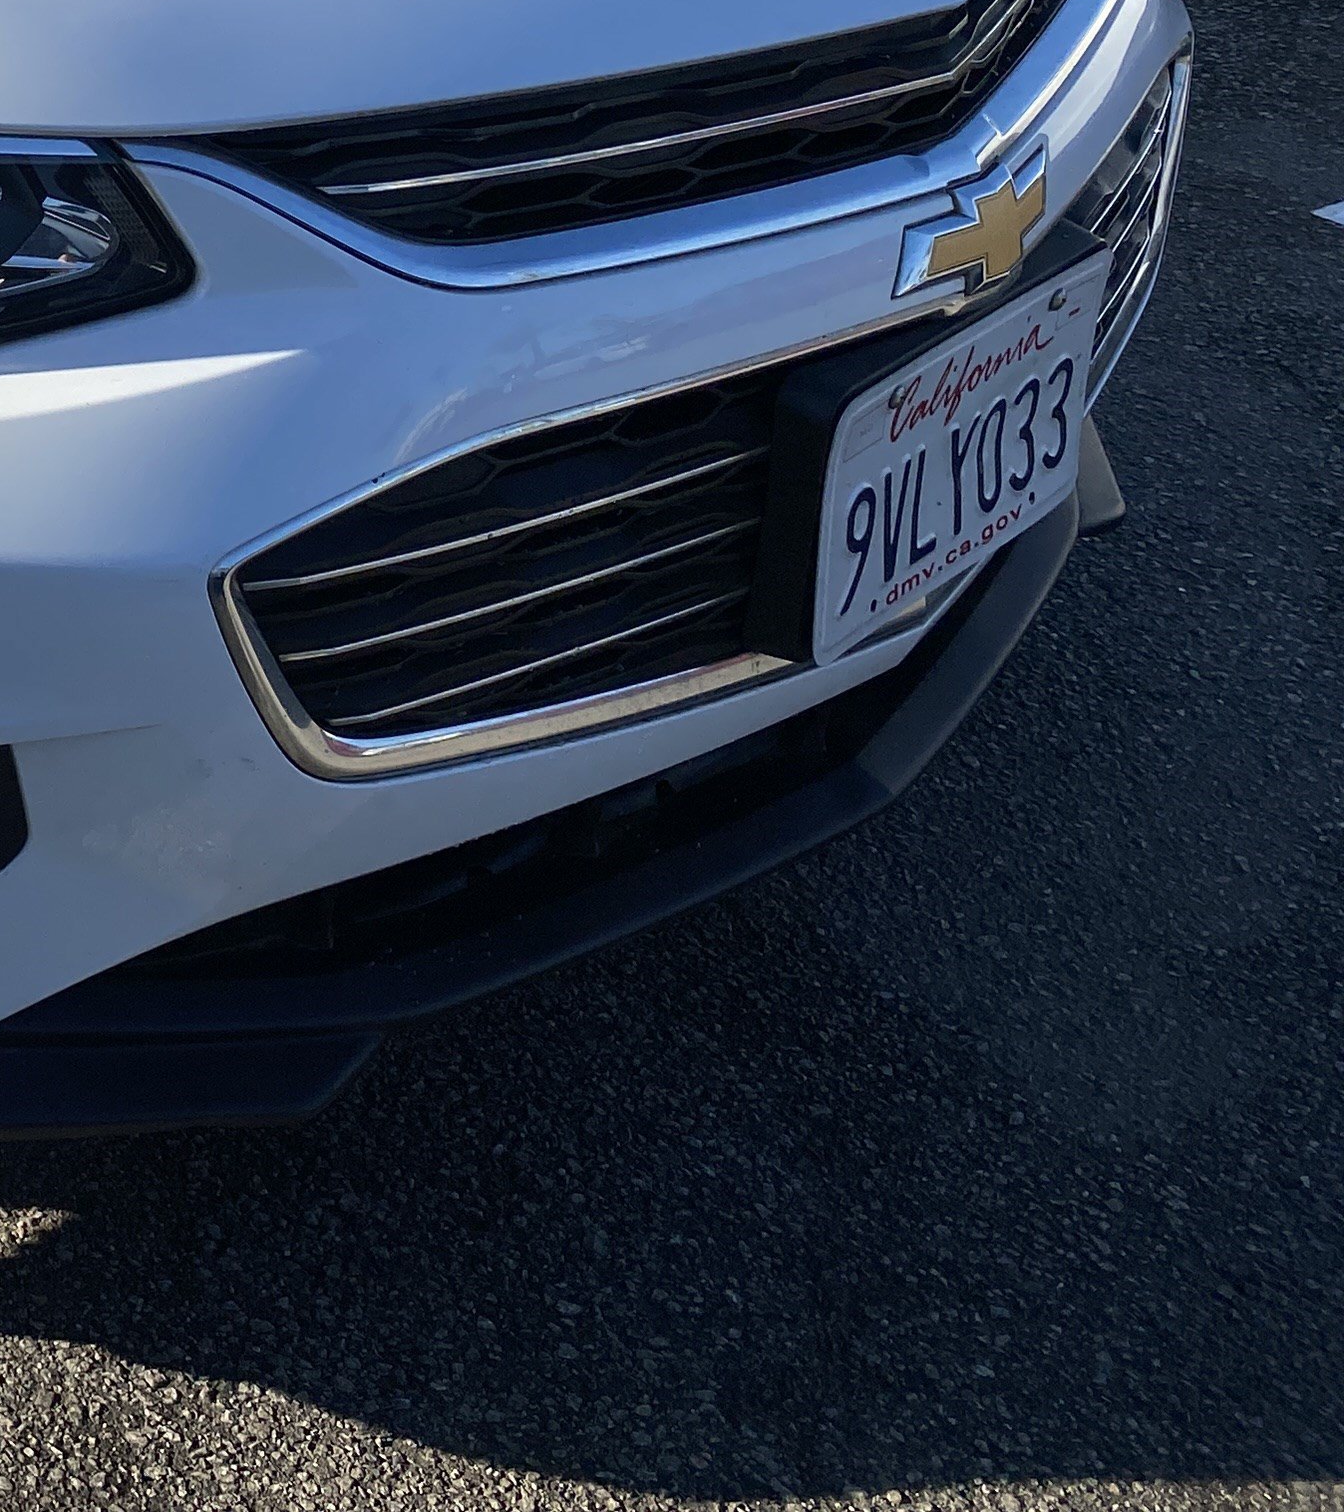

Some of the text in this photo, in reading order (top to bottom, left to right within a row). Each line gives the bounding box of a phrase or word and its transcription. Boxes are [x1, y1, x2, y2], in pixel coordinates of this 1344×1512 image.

[890, 315, 1053, 442] California
[839, 358, 1074, 616] 9VLY033
[886, 503, 1023, 604] dmv.ca.gov
